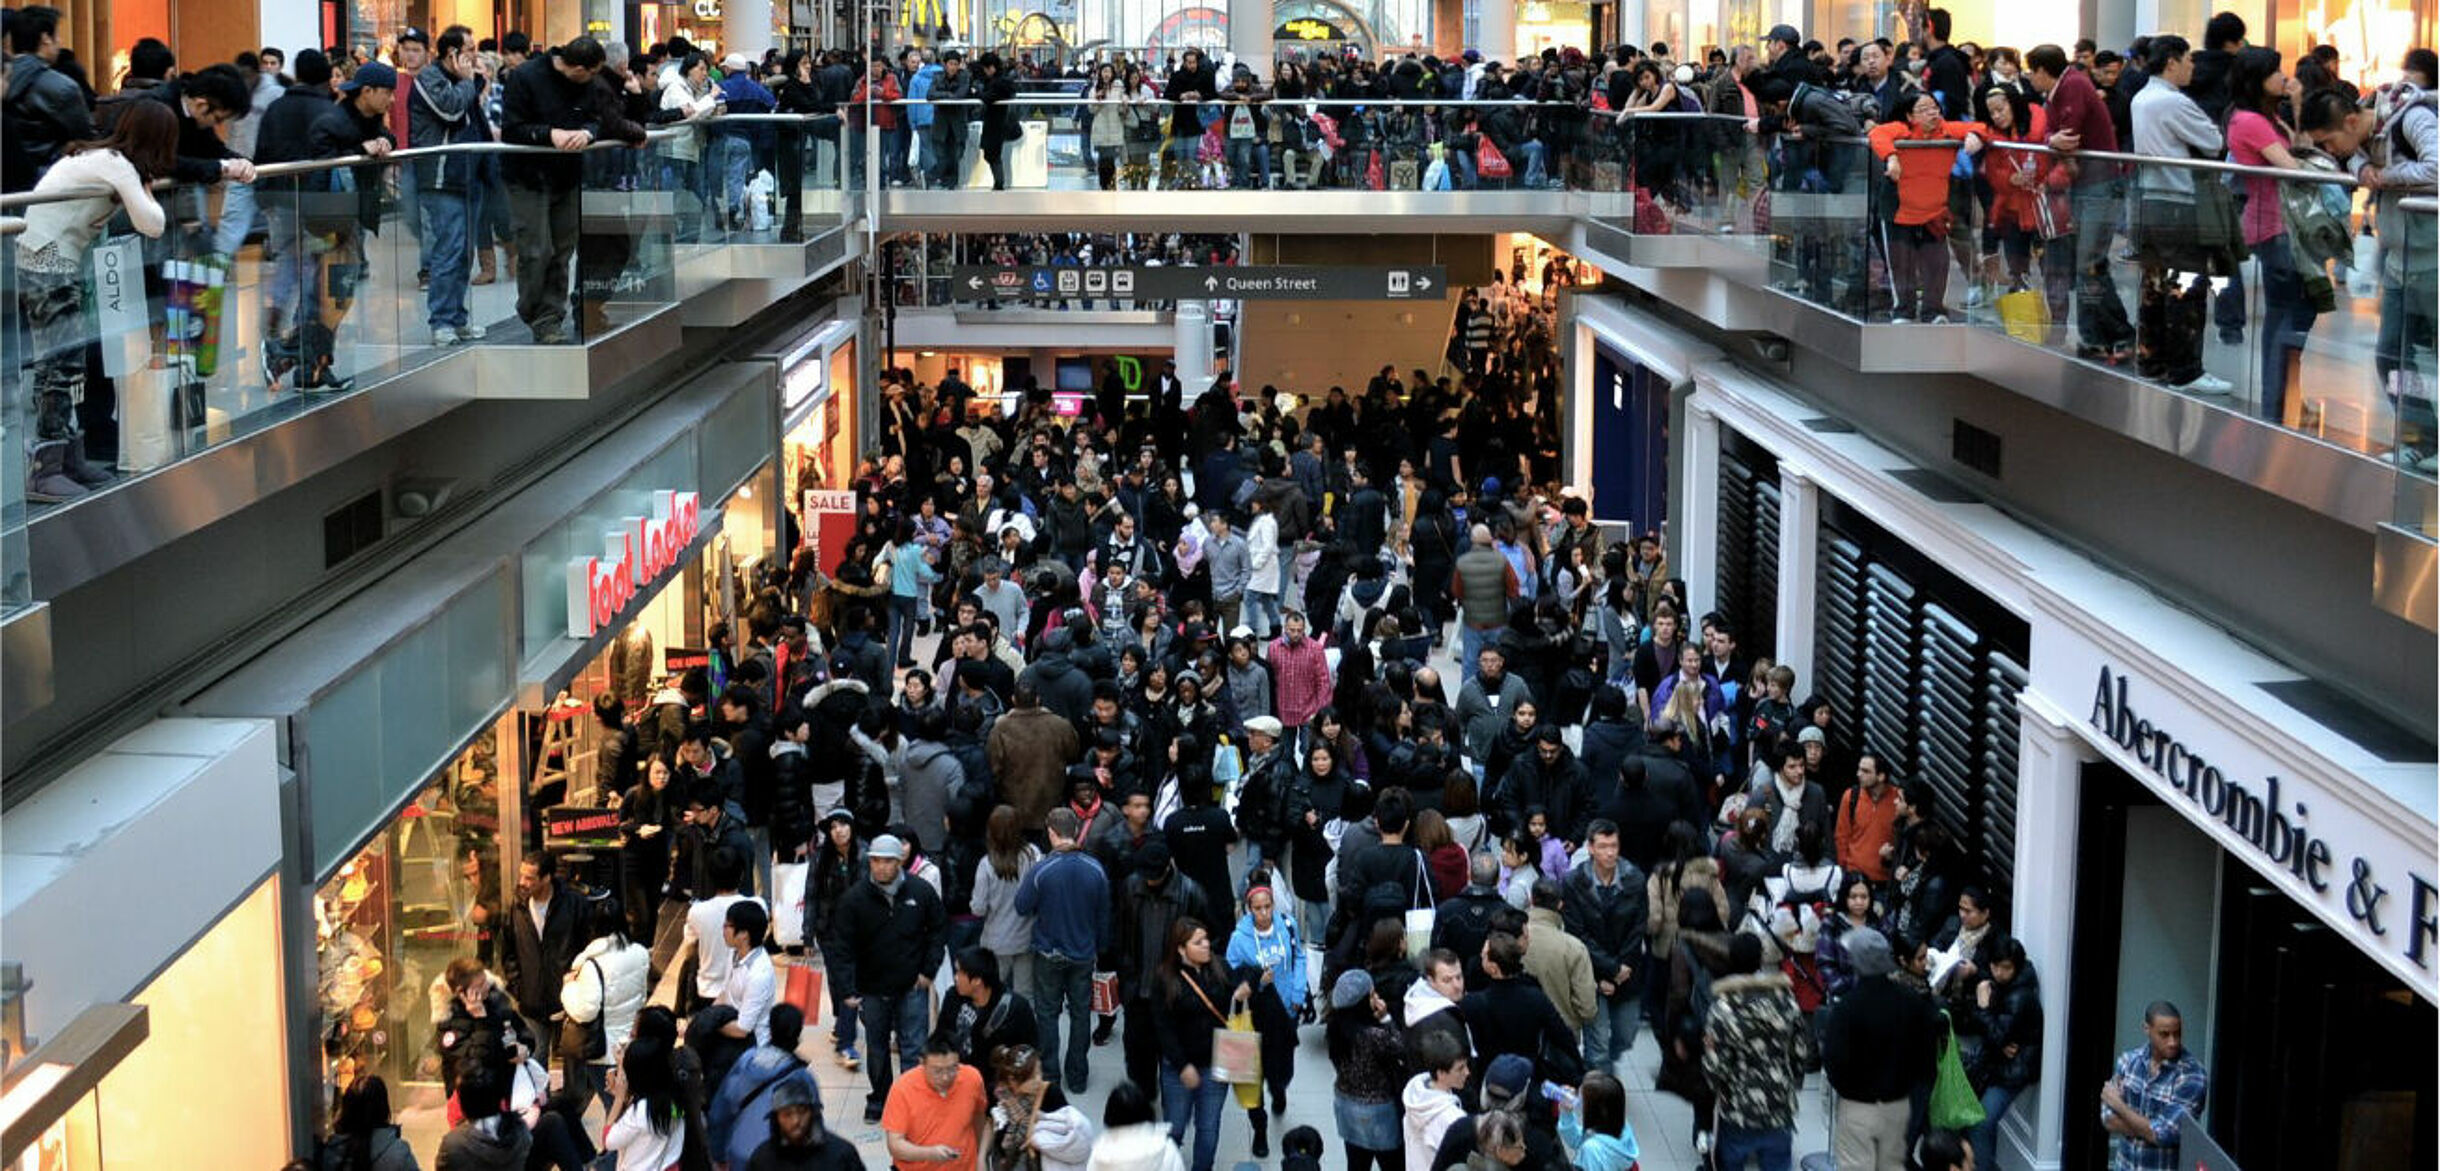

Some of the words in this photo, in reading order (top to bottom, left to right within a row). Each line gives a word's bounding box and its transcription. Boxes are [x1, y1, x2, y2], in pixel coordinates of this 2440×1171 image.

[104, 251, 120, 312] ALDO
[1226, 277, 1271, 290] Queen
[1275, 276, 1317, 290] Street
[810, 495, 850, 510] SALE
[2089, 664, 2332, 893] Abercrombie
[2346, 856, 2389, 937] &
[551, 820, 575, 835] NEW
[575, 812, 620, 832] ARRIVALS
